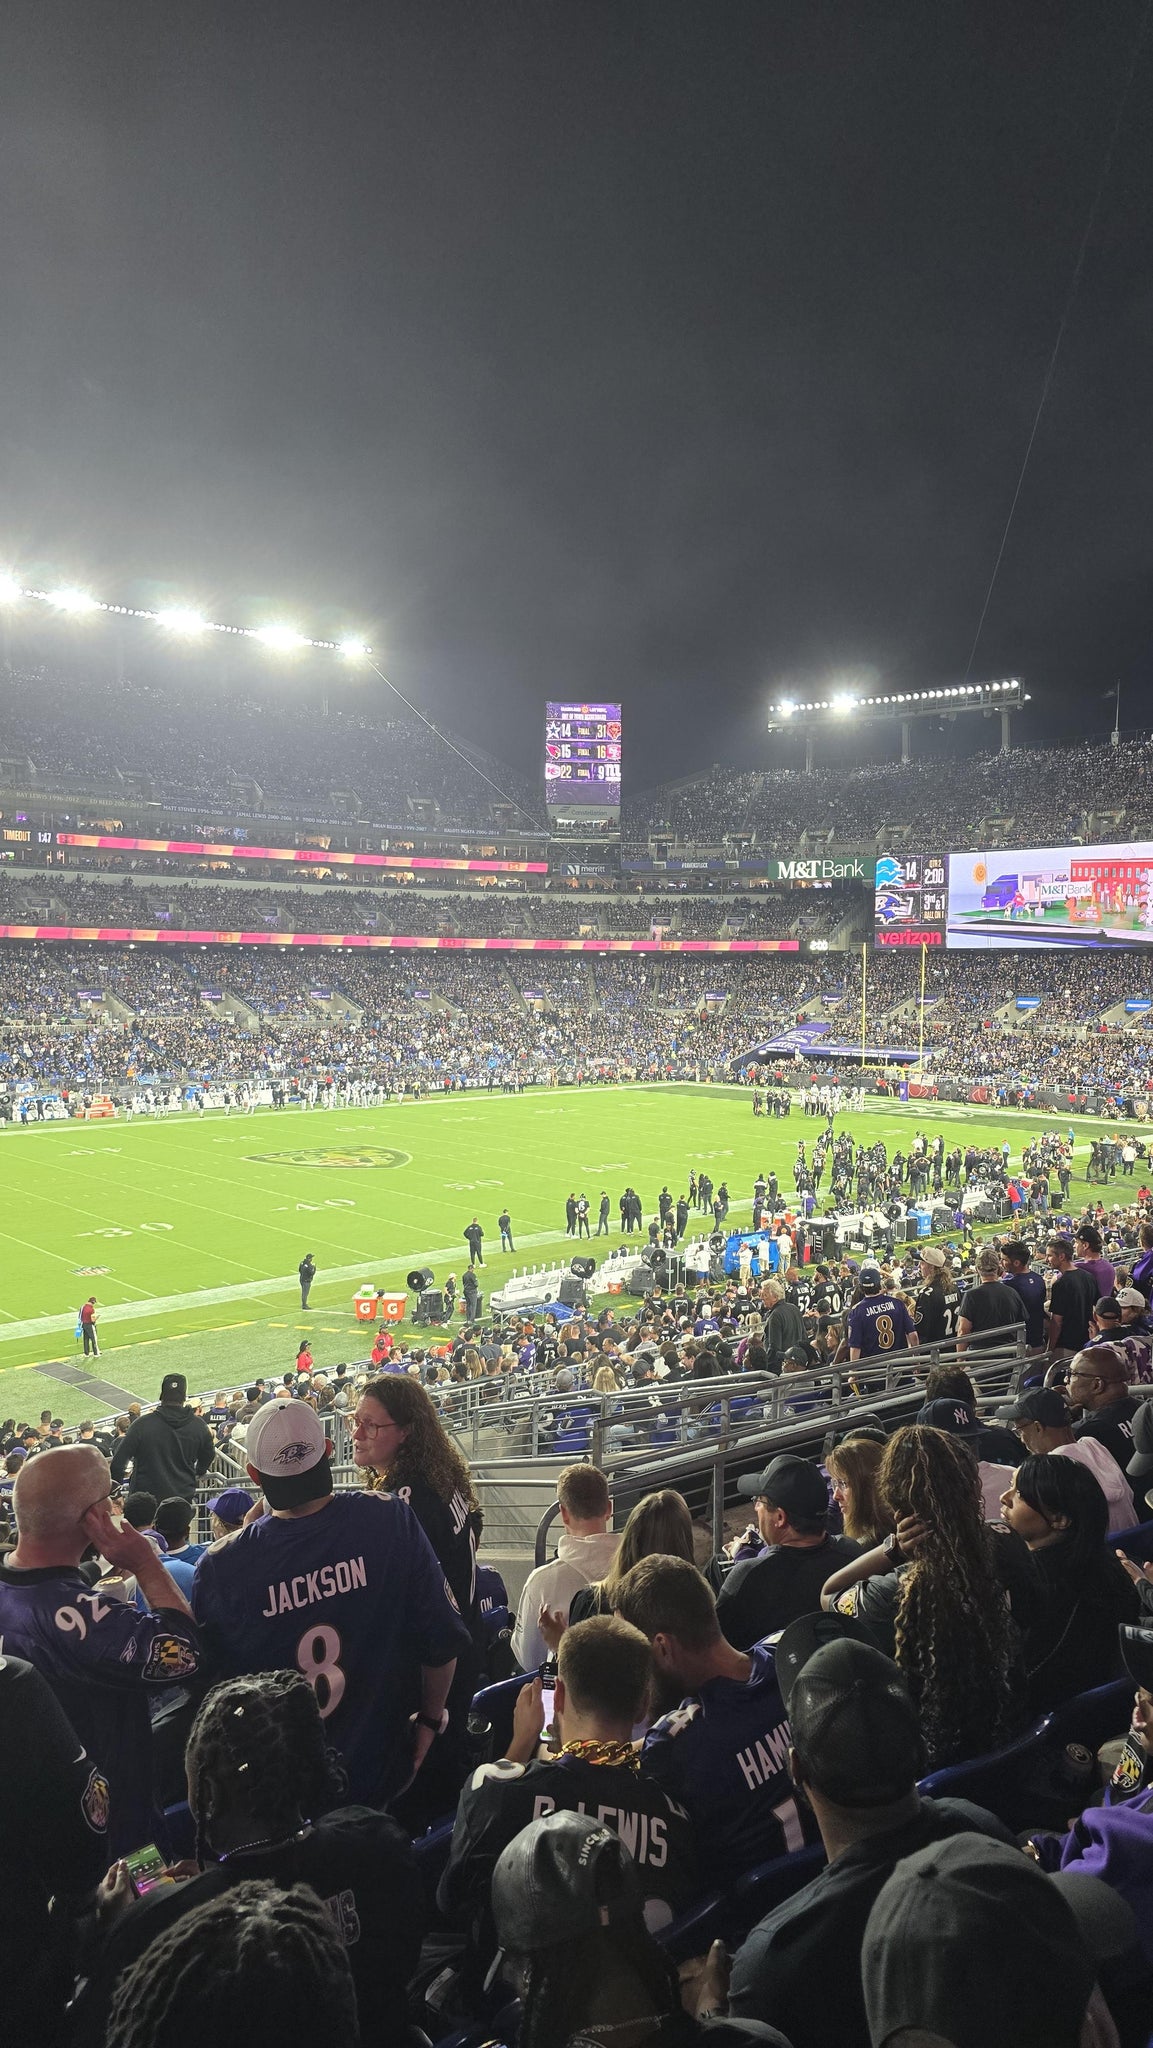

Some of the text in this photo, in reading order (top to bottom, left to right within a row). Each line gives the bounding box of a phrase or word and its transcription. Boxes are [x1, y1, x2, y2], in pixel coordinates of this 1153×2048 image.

[561, 723, 571, 737] 14
[597, 724, 606, 738] 31
[561, 744, 571, 758] 15
[578, 748, 590, 756] FINAL
[597, 745, 606, 758] 16
[560, 765, 572, 779] 22
[578, 769, 590, 777] FINAL
[598, 766, 604, 780] 9
[571, 807, 608, 816] Constellation
[3, 829, 52, 843] TIMEOUT 1:47
[777, 859, 864, 879] M&T Bank
[906, 861, 917, 880] 14
[925, 868, 944, 884] 2:00
[1041, 882, 1092, 895] M&T Bank
[906, 896, 914, 915] 7
[924, 894, 936, 910] 3rd
[878, 929, 942, 945] verizon
[295, 1198, 356, 1212] 40
[94, 1222, 174, 1238] 30
[798, 1296, 810, 1312] 52
[944, 1293, 958, 1304] HENRY
[360, 1302, 370, 1314] G
[387, 1303, 398, 1314] G
[866, 1301, 895, 1317] JACKSON
[876, 1314, 895, 1349] 8
[954, 1408, 969, 1424] NY
[262, 1556, 367, 1618] JACKSON
[55, 1593, 112, 1640] 92
[298, 1624, 346, 1720] 8
